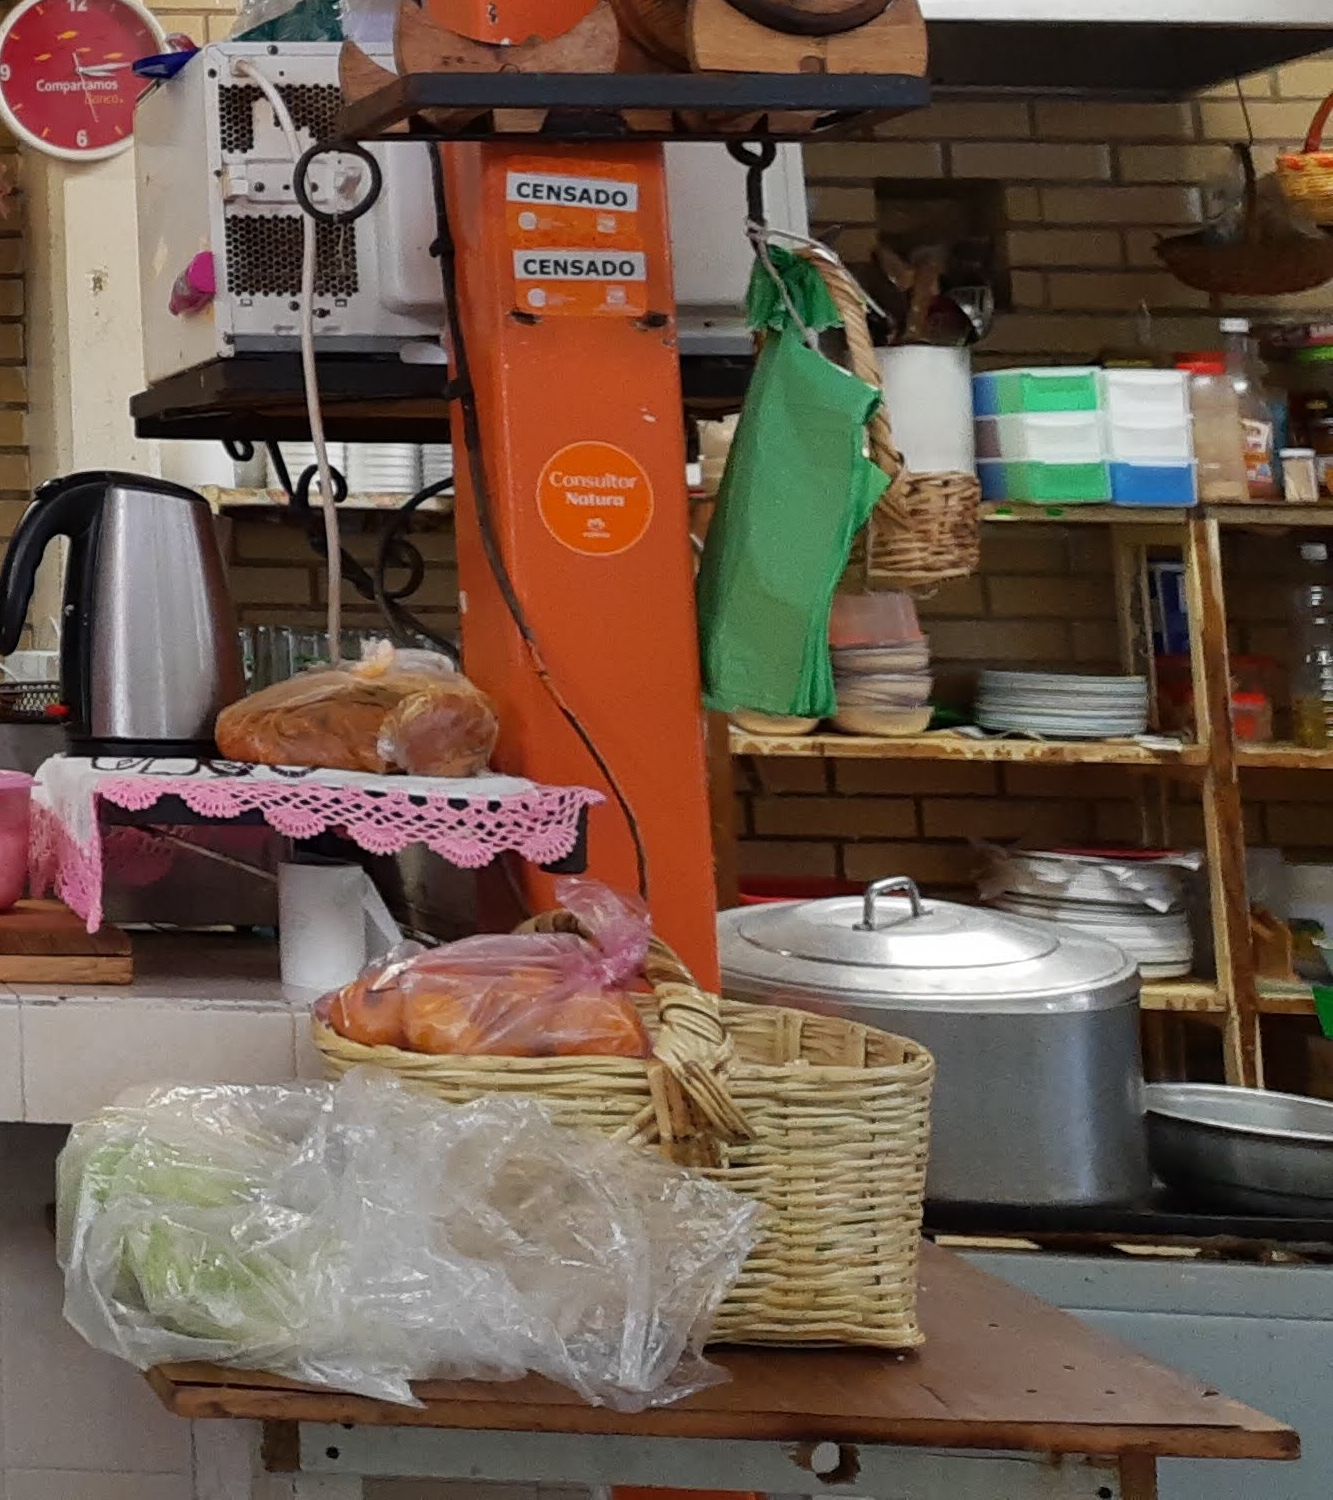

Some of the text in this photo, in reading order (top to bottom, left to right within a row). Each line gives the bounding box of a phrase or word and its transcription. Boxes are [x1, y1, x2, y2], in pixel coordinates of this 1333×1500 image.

[0, 64, 11, 81] 9
[36, 79, 118, 95] Compartamos
[76, 130, 88, 147] 6
[516, 182, 628, 207] CENSADO
[523, 258, 636, 277] CENSADO
[565, 492, 625, 507] Natura
